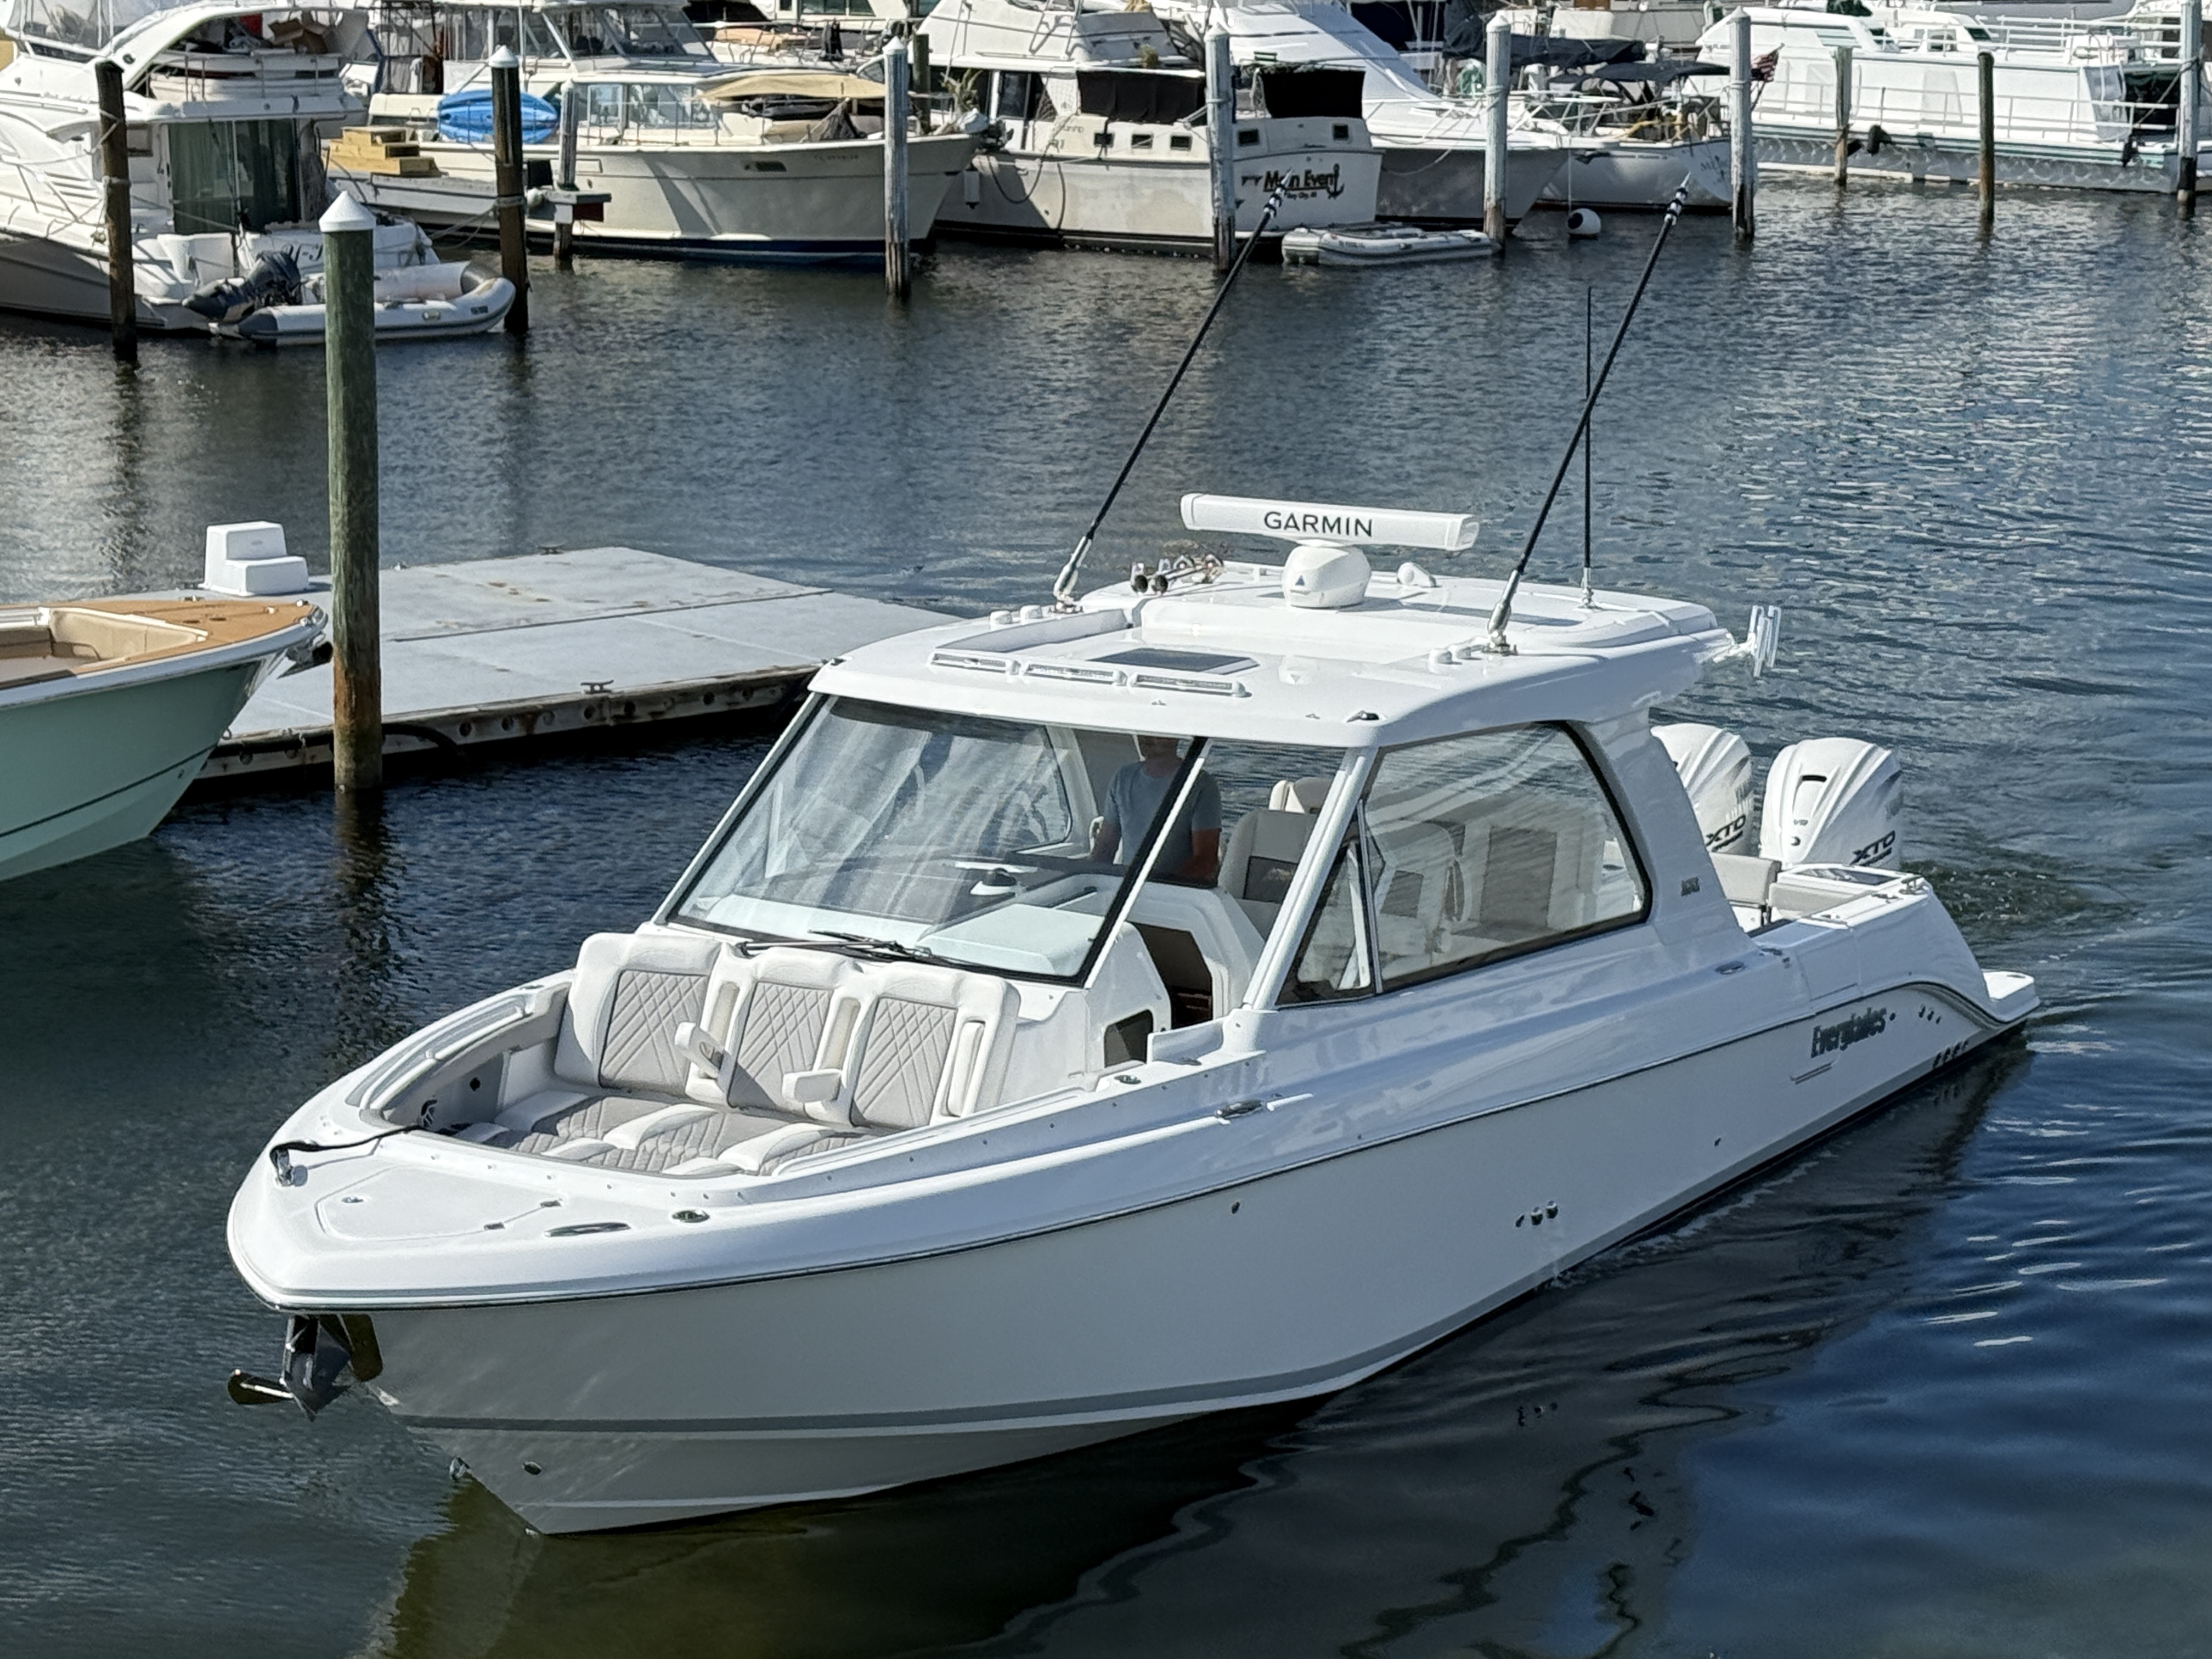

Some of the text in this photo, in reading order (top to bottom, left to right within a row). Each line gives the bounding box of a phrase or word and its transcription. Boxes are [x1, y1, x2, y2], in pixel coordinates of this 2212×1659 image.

[1263, 170, 1300, 189] Man
[1264, 511, 1373, 537] GARMIN
[1706, 813, 1746, 847] XTO
[1849, 830, 1896, 865] XTO
